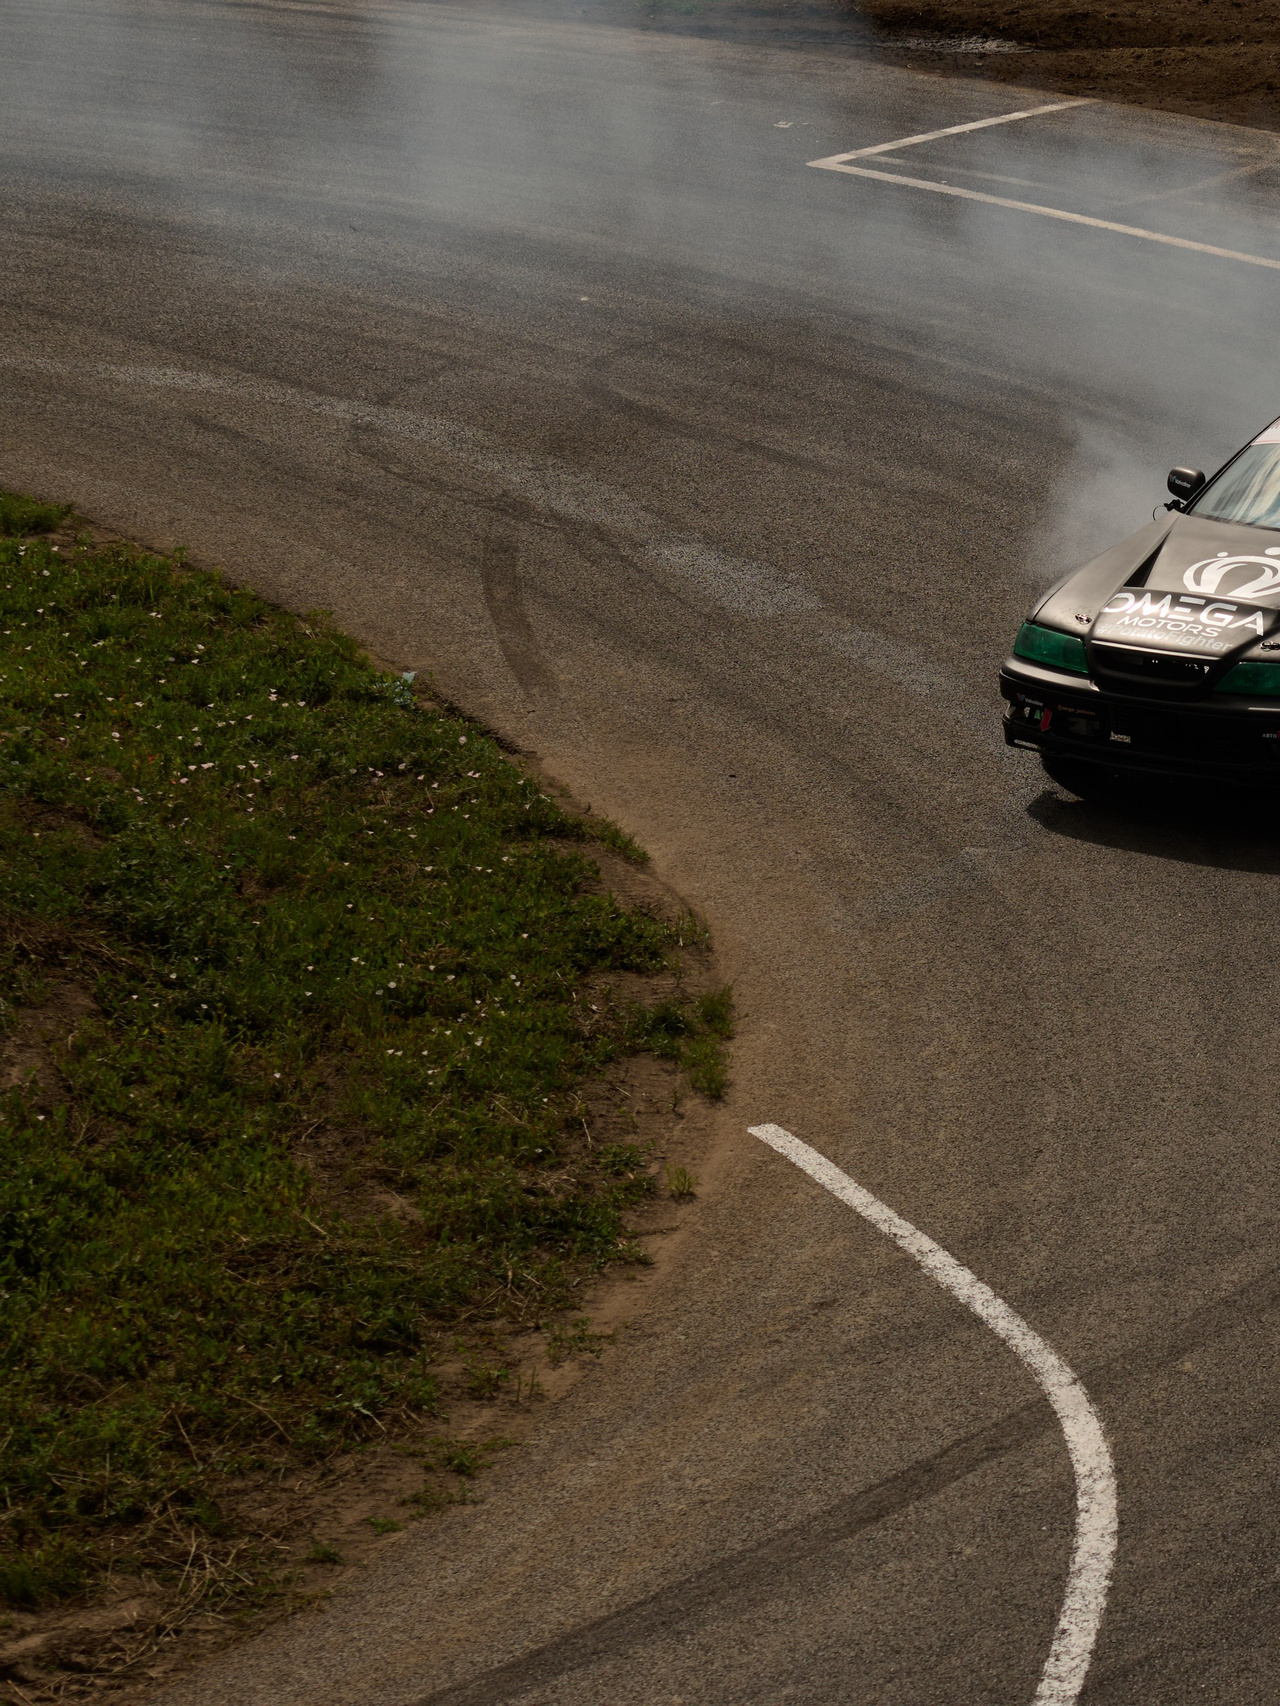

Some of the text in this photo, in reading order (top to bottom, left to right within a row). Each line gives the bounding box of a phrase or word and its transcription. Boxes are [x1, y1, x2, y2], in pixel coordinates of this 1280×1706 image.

[1100, 592, 1265, 637] OMEGA
[1117, 615, 1222, 638] MOTORS
[1097, 624, 1234, 652] #PotatoFighter
